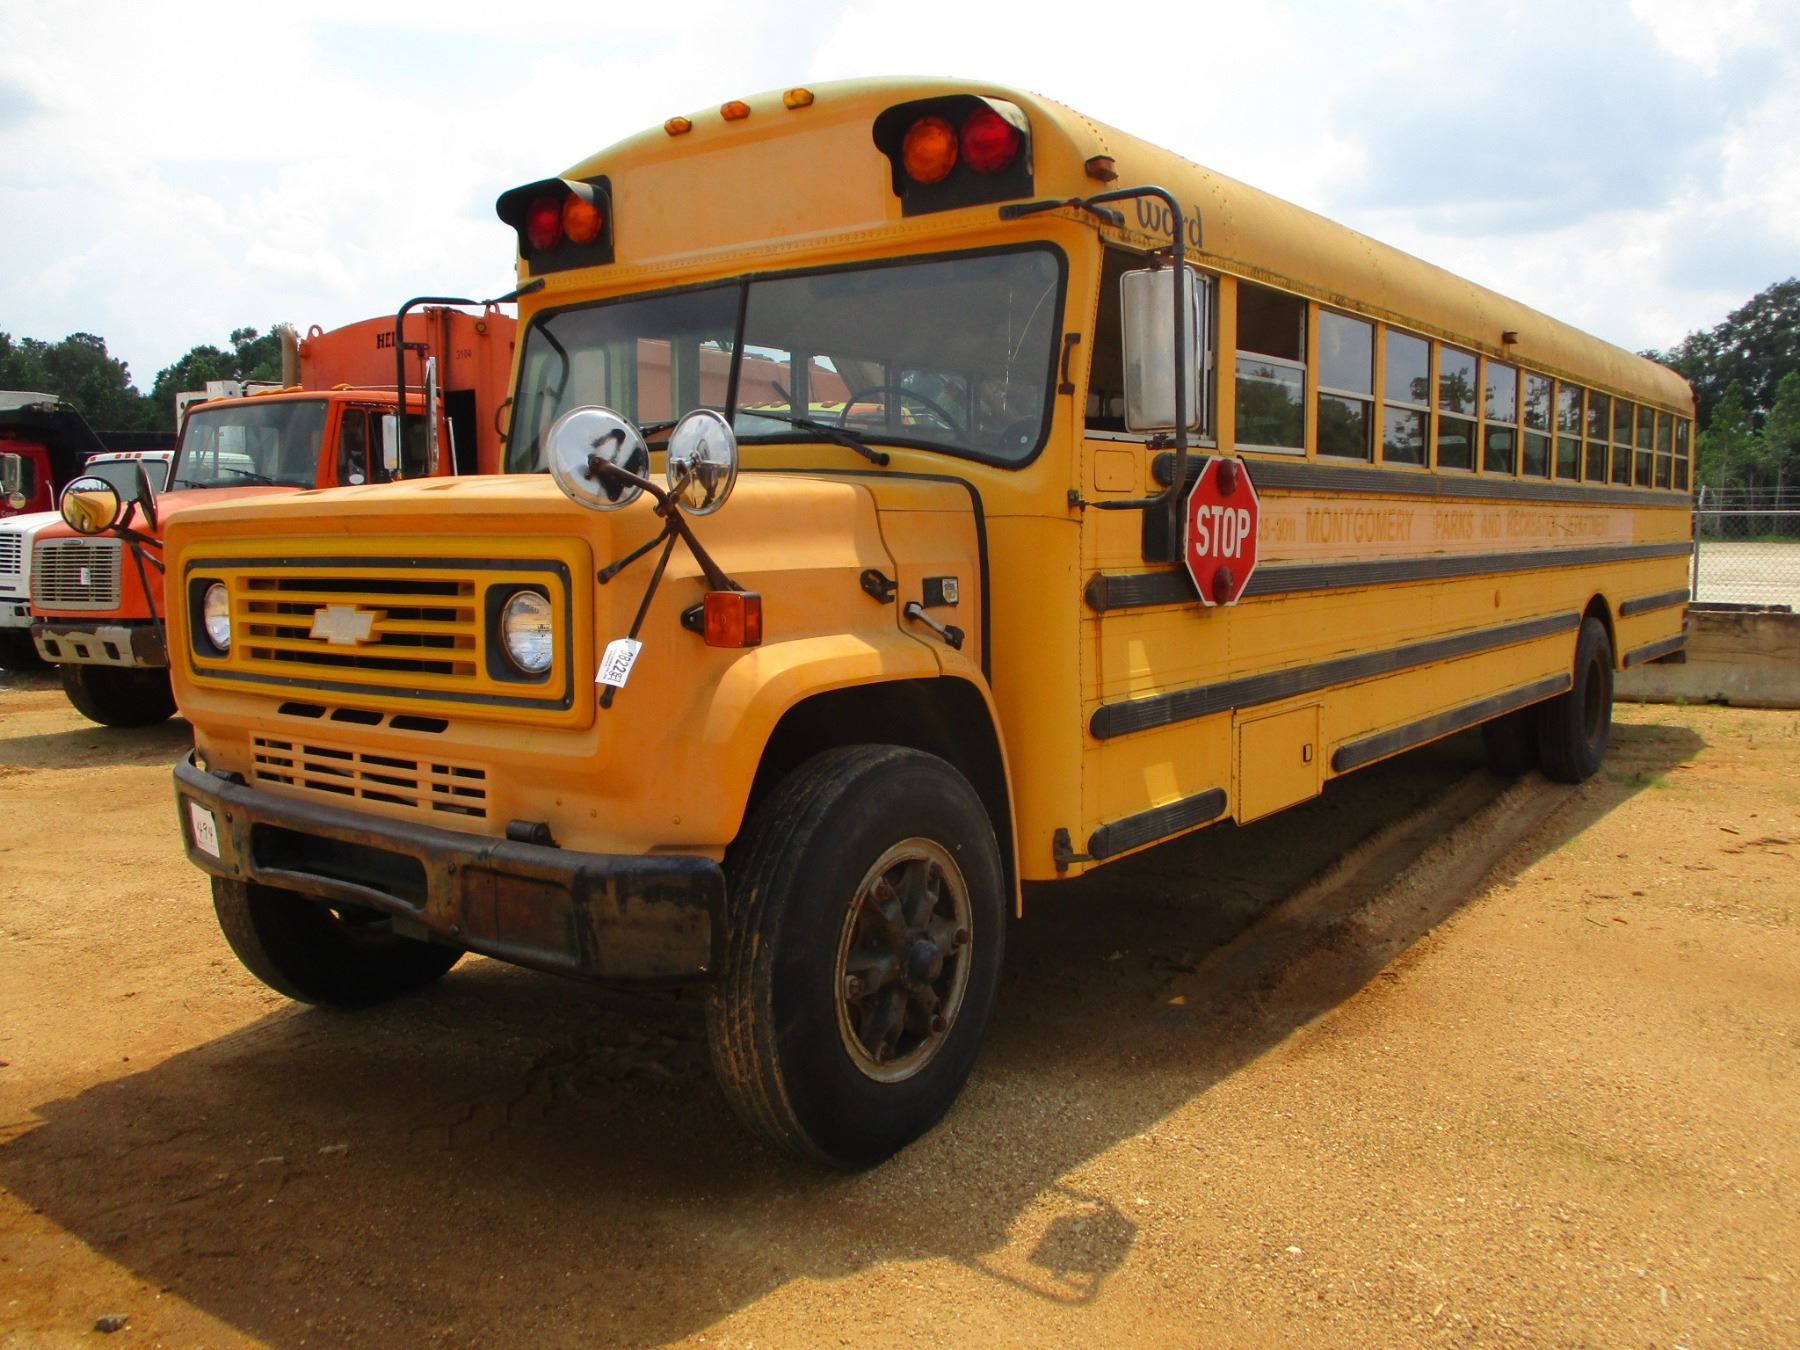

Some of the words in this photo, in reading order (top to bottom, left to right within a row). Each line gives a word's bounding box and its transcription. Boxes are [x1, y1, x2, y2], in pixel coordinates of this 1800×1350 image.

[376, 332, 396, 349] HEI
[1195, 504, 1251, 559] STOP
[1305, 507, 1415, 544] MONTGOMERY
